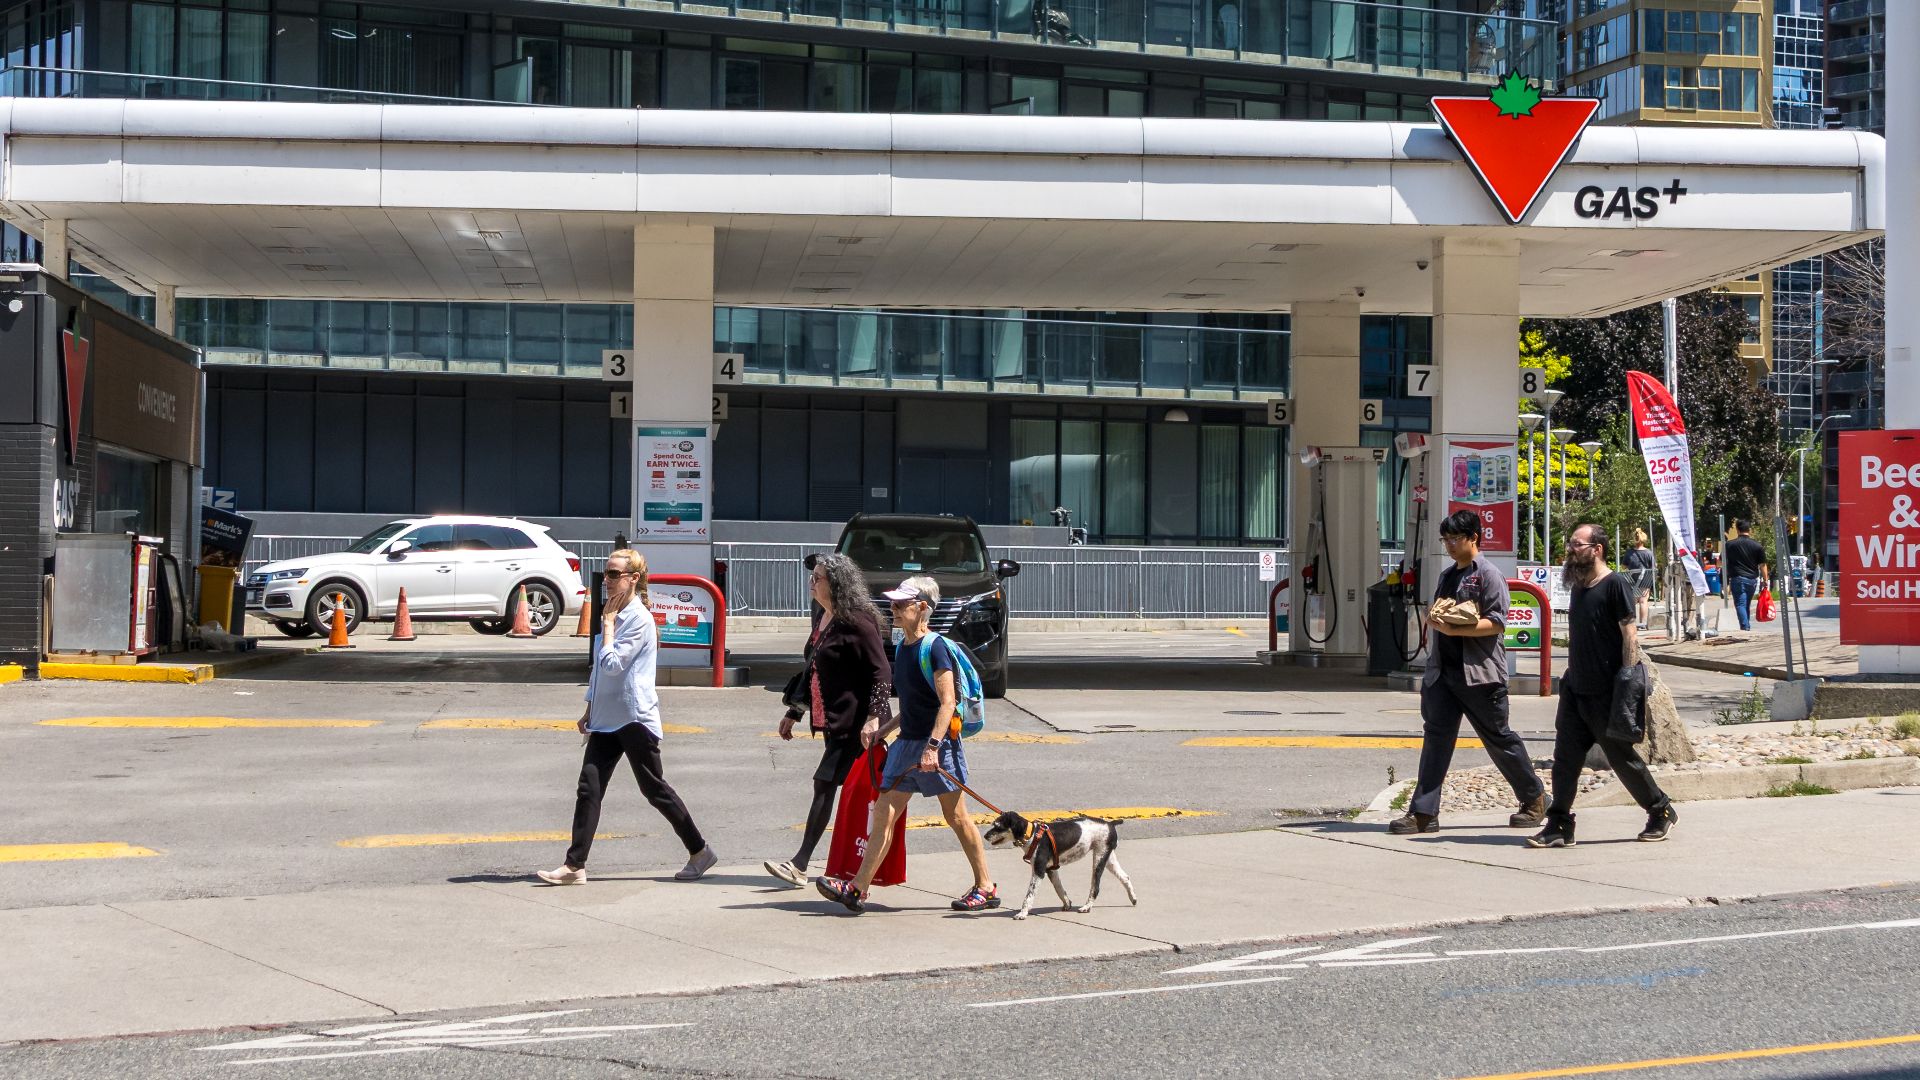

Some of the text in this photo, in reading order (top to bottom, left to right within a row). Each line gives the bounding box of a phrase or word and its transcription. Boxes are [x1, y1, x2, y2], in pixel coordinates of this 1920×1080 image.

[1574, 179, 1687, 220] GAS+
[610, 354, 626, 377] 3
[720, 358, 736, 380] 4
[1415, 370, 1431, 391] 7
[1522, 372, 1537, 394] 8
[137, 382, 176, 423] CONVENIENCE
[618, 396, 627, 414] 1
[712, 397, 721, 415] 2
[1274, 403, 1287, 421] 5
[1363, 403, 1376, 421] 6
[1646, 411, 1670, 419] Triangle
[1642, 417, 1675, 426] Mastercard
[646, 460, 701, 468] EARN TWICE.
[1663, 475, 1682, 484] litre
[1889, 494, 1920, 529] &
[213, 520, 243, 535] Mark's
[1856, 580, 1899, 599] Sold
[673, 604, 707, 613] Rewards
[1507, 609, 1533, 621] ESS
